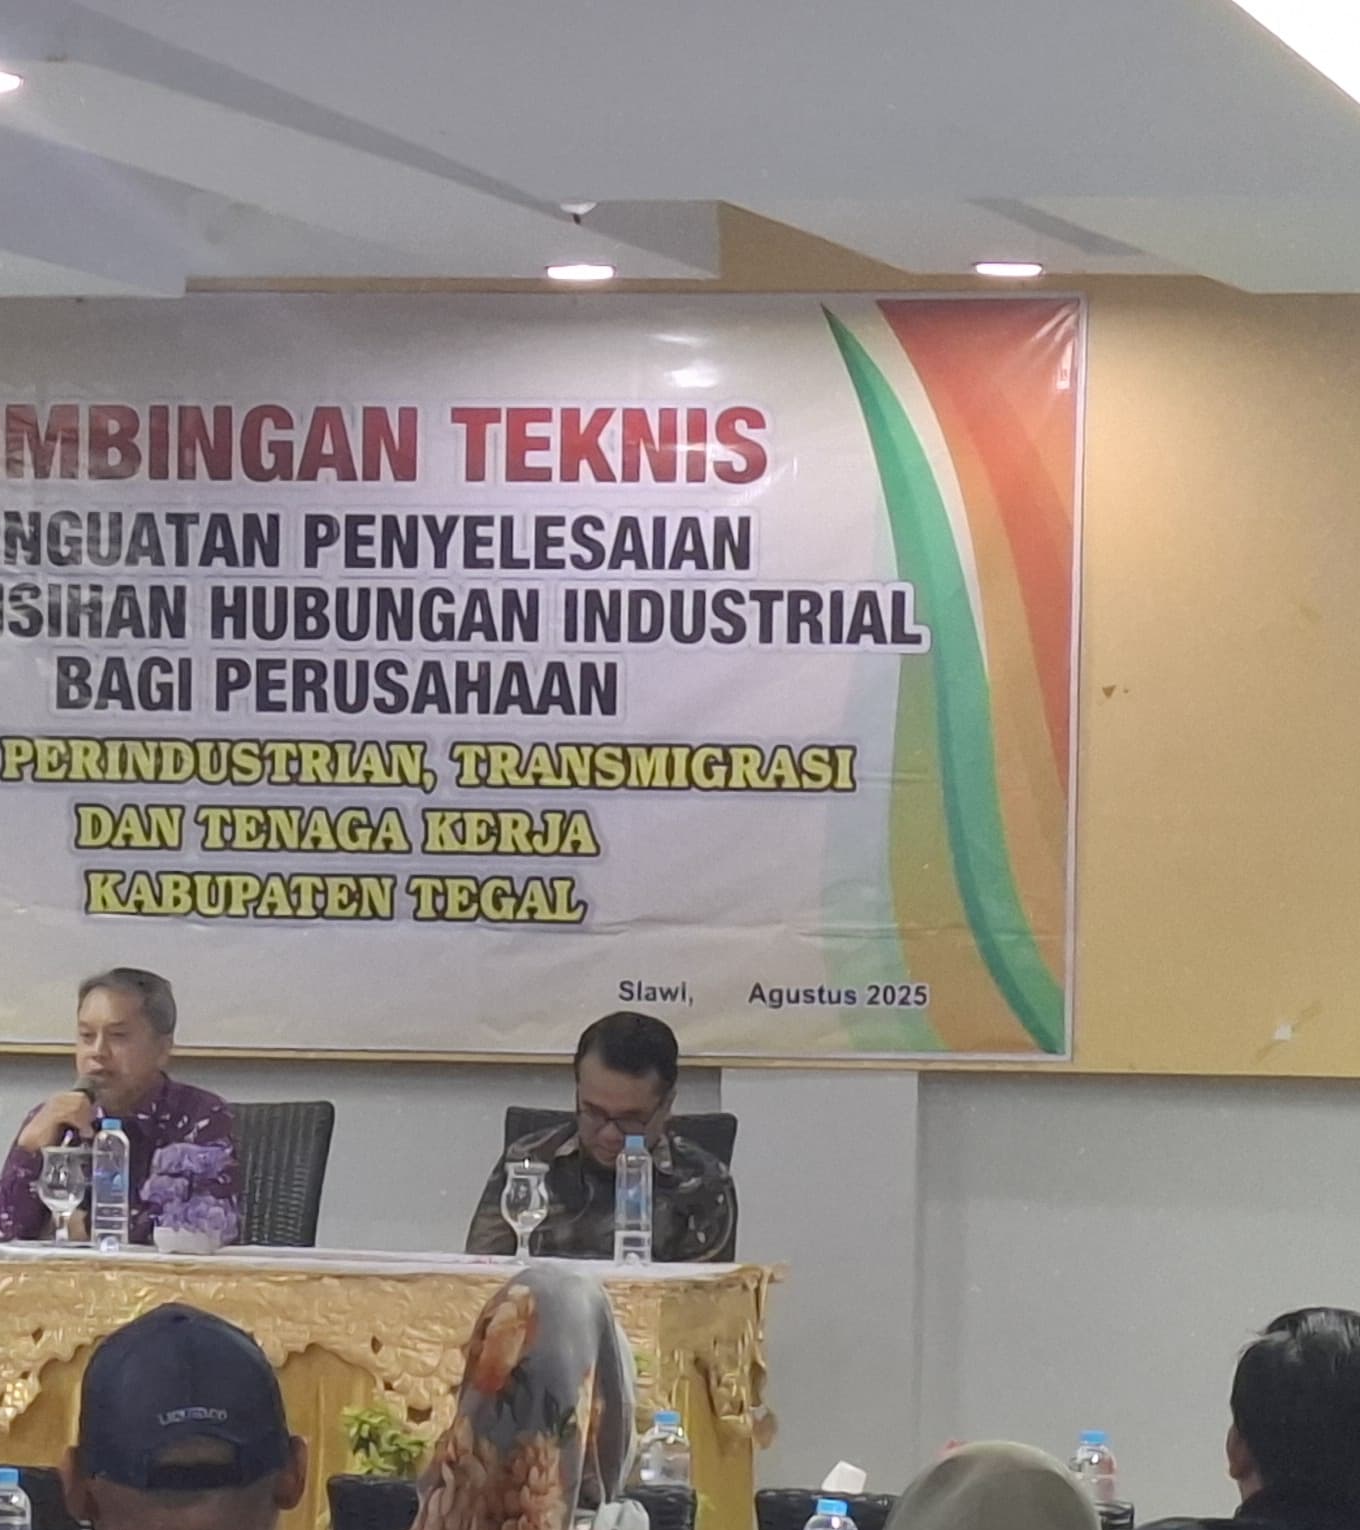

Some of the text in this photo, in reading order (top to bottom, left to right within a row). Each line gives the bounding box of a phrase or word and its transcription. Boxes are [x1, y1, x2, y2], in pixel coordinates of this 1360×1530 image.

[451, 406, 769, 484] TEKNIS
[303, 513, 752, 571] PENYELESAIAN
[210, 585, 539, 641] HUBUNGAN
[564, 588, 923, 645] INDUSTRIAL
[55, 656, 618, 716] BAGI PERUSAHAAN
[451, 743, 857, 791] TRANSMIGRASI
[74, 803, 600, 857] DAN TENAGA KERJA
[84, 870, 587, 924] KABUPATEN TEGAL
[618, 980, 928, 1008] Slawi, Agustus 2025
